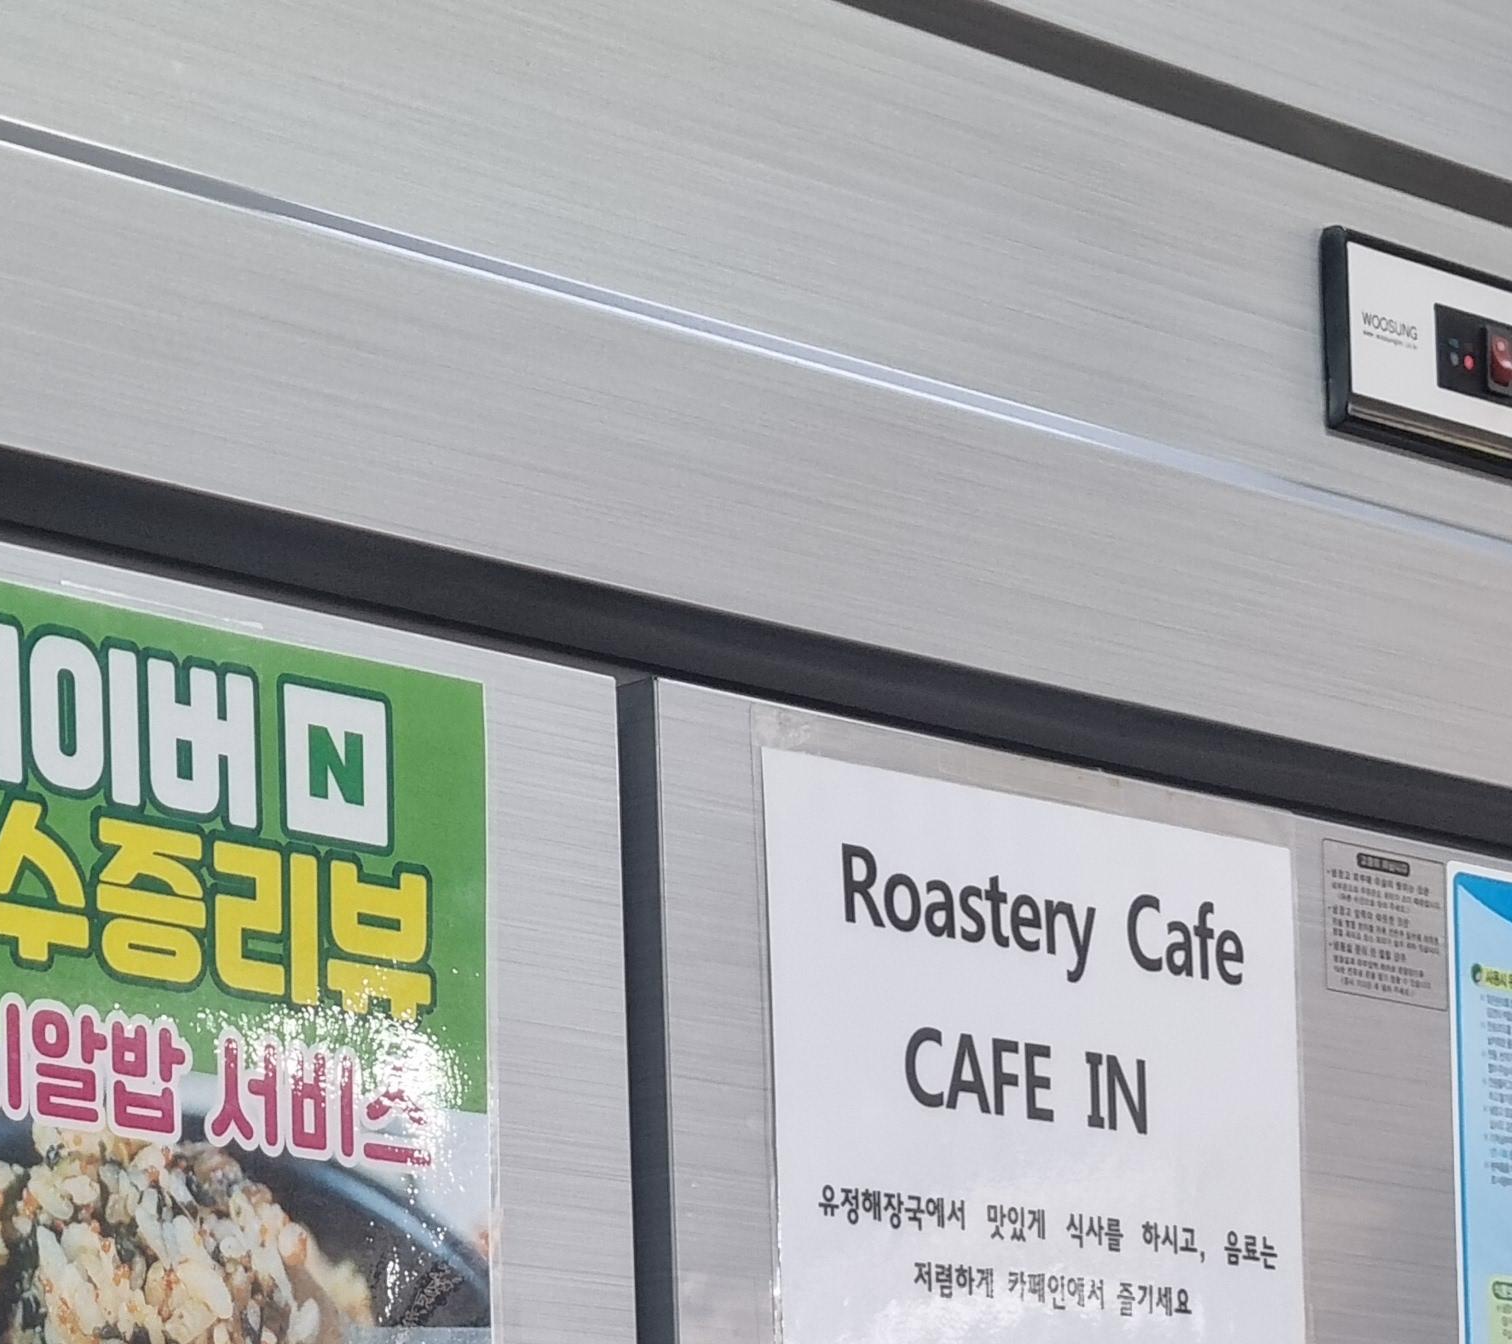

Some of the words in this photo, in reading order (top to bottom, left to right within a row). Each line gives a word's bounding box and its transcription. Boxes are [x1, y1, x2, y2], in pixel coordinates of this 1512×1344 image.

[1361, 311, 1418, 341] WOOSUNG
[841, 842, 1096, 984] Roastery
[1126, 893, 1245, 986] Cafe
[211, 1038, 431, 1167] 서비스
[904, 1026, 1055, 1123] CAFE
[1085, 1050, 1148, 1136] IN
[818, 1184, 966, 1232] 유정해장국에서
[987, 1204, 1046, 1243] 맛있게
[1066, 1213, 1124, 1253] 식사를
[1142, 1220, 1206, 1263] 하시고,
[1224, 1230, 1278, 1271] 음료는
[913, 1261, 994, 1299] 저렴하게
[1007, 1270, 1105, 1311] 카페인에서
[1116, 1281, 1192, 1317] 즐기세요
